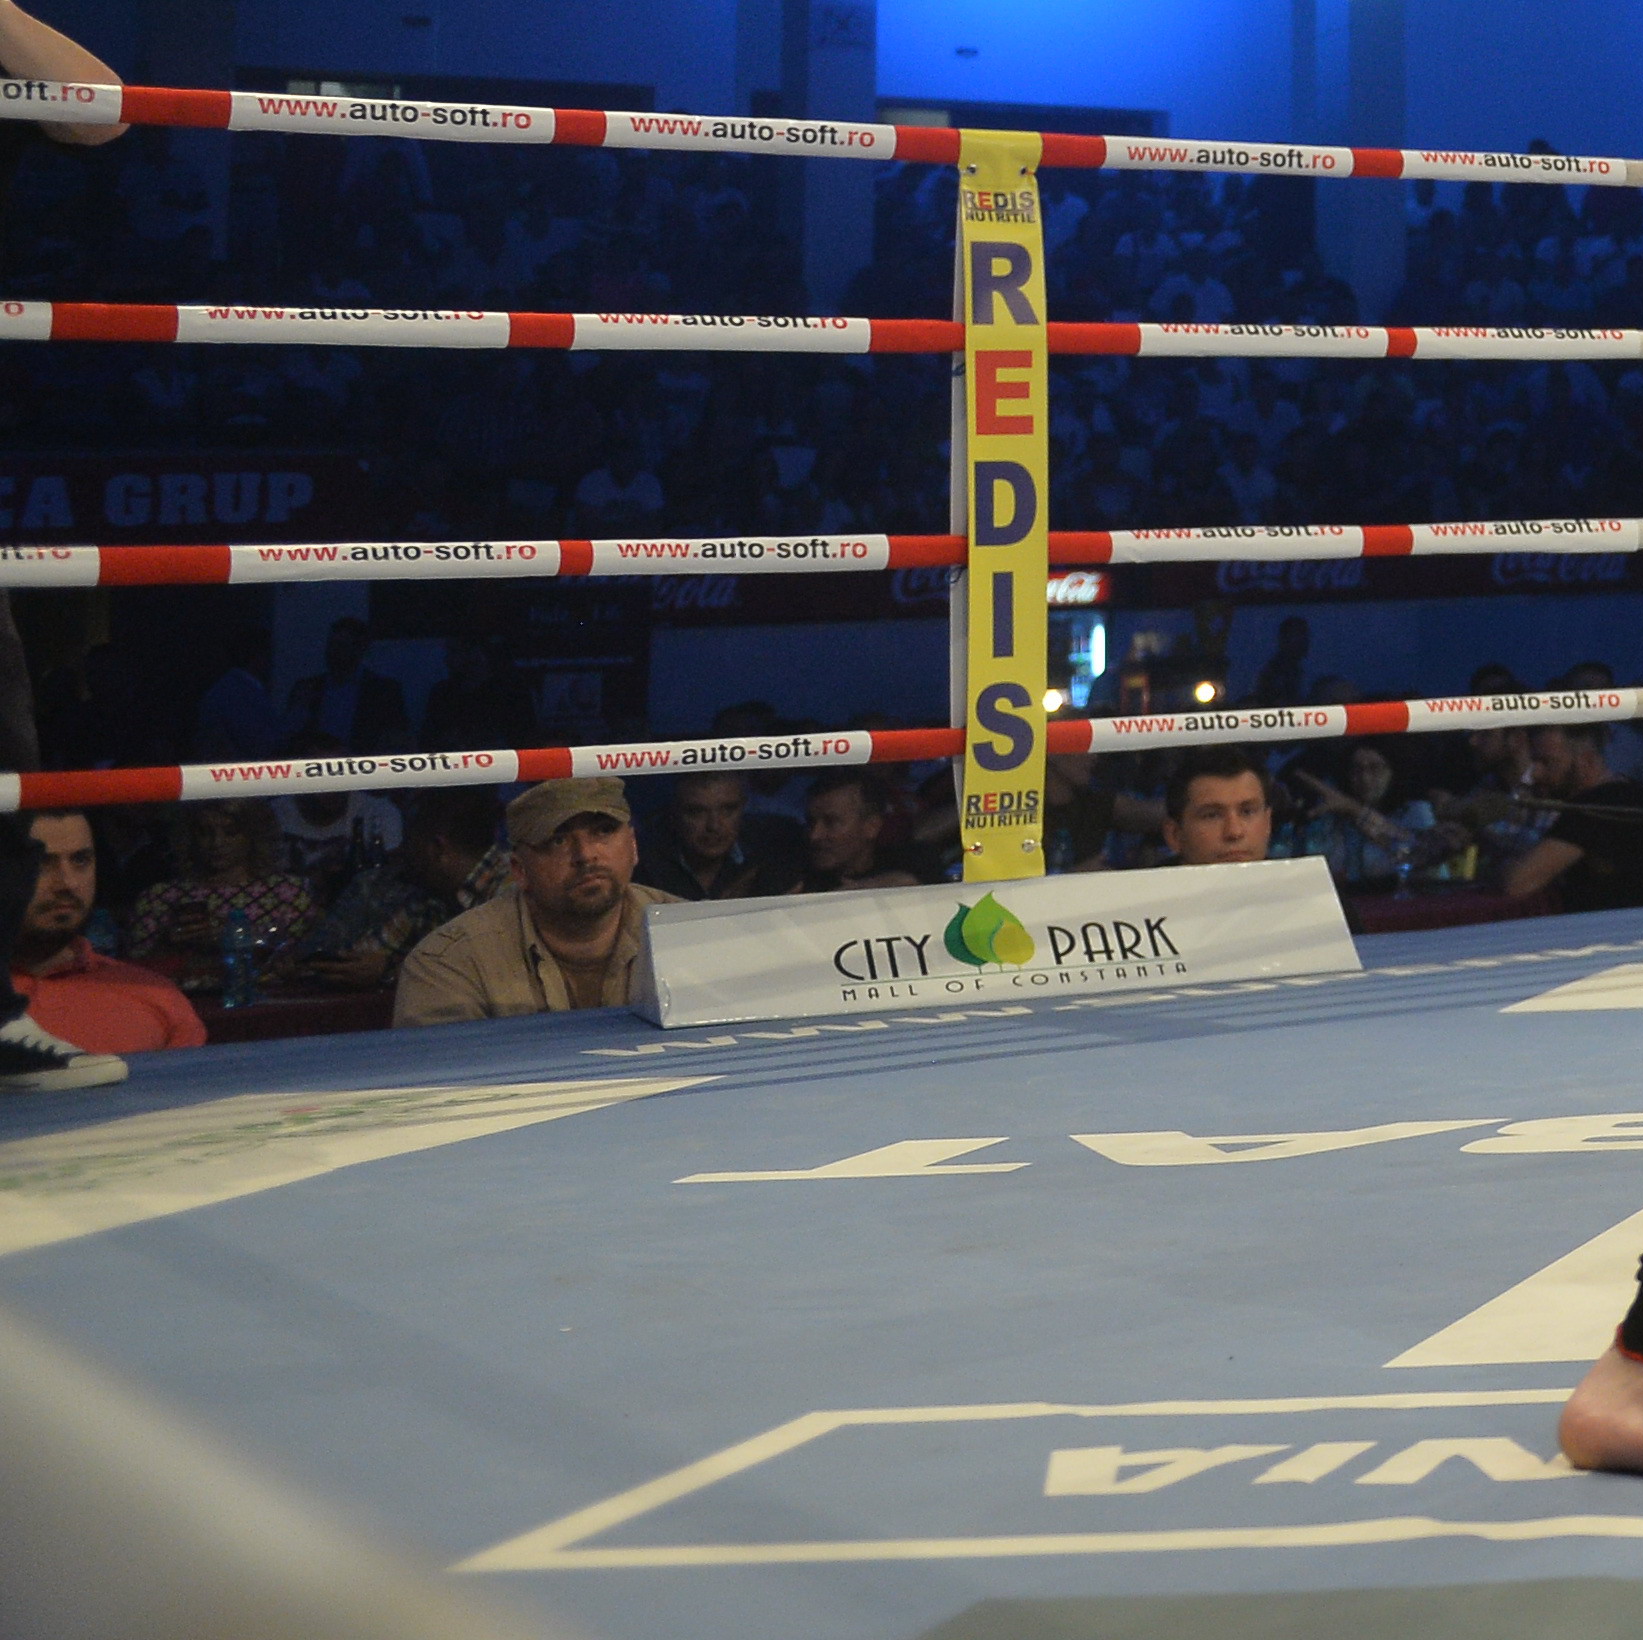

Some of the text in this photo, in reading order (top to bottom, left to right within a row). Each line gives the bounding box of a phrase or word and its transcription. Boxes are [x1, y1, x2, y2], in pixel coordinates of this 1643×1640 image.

[258, 93, 533, 130] www.auto-soft.ro
[630, 114, 875, 150] www.auto-soft.ro
[1127, 144, 1337, 171] www.auto-soft.ro
[962, 189, 1036, 212] REDIS
[102, 470, 313, 527] GRUP
[969, 241, 1041, 772] REDIS
[259, 539, 537, 563] www.auto-soft.ro
[617, 536, 868, 562] www.auto-soft.ro
[1112, 707, 1329, 734] www.auto-soft.ro
[1427, 693, 1622, 715] www.auto-soft.ro
[211, 747, 496, 785] www.auto-soft.ro
[597, 732, 852, 772] www.auto-soft.ro
[967, 788, 1040, 816] REDIS
[833, 916, 1182, 982] CITY PARK
[842, 960, 1190, 1002] MALL OF CONSTANTA
